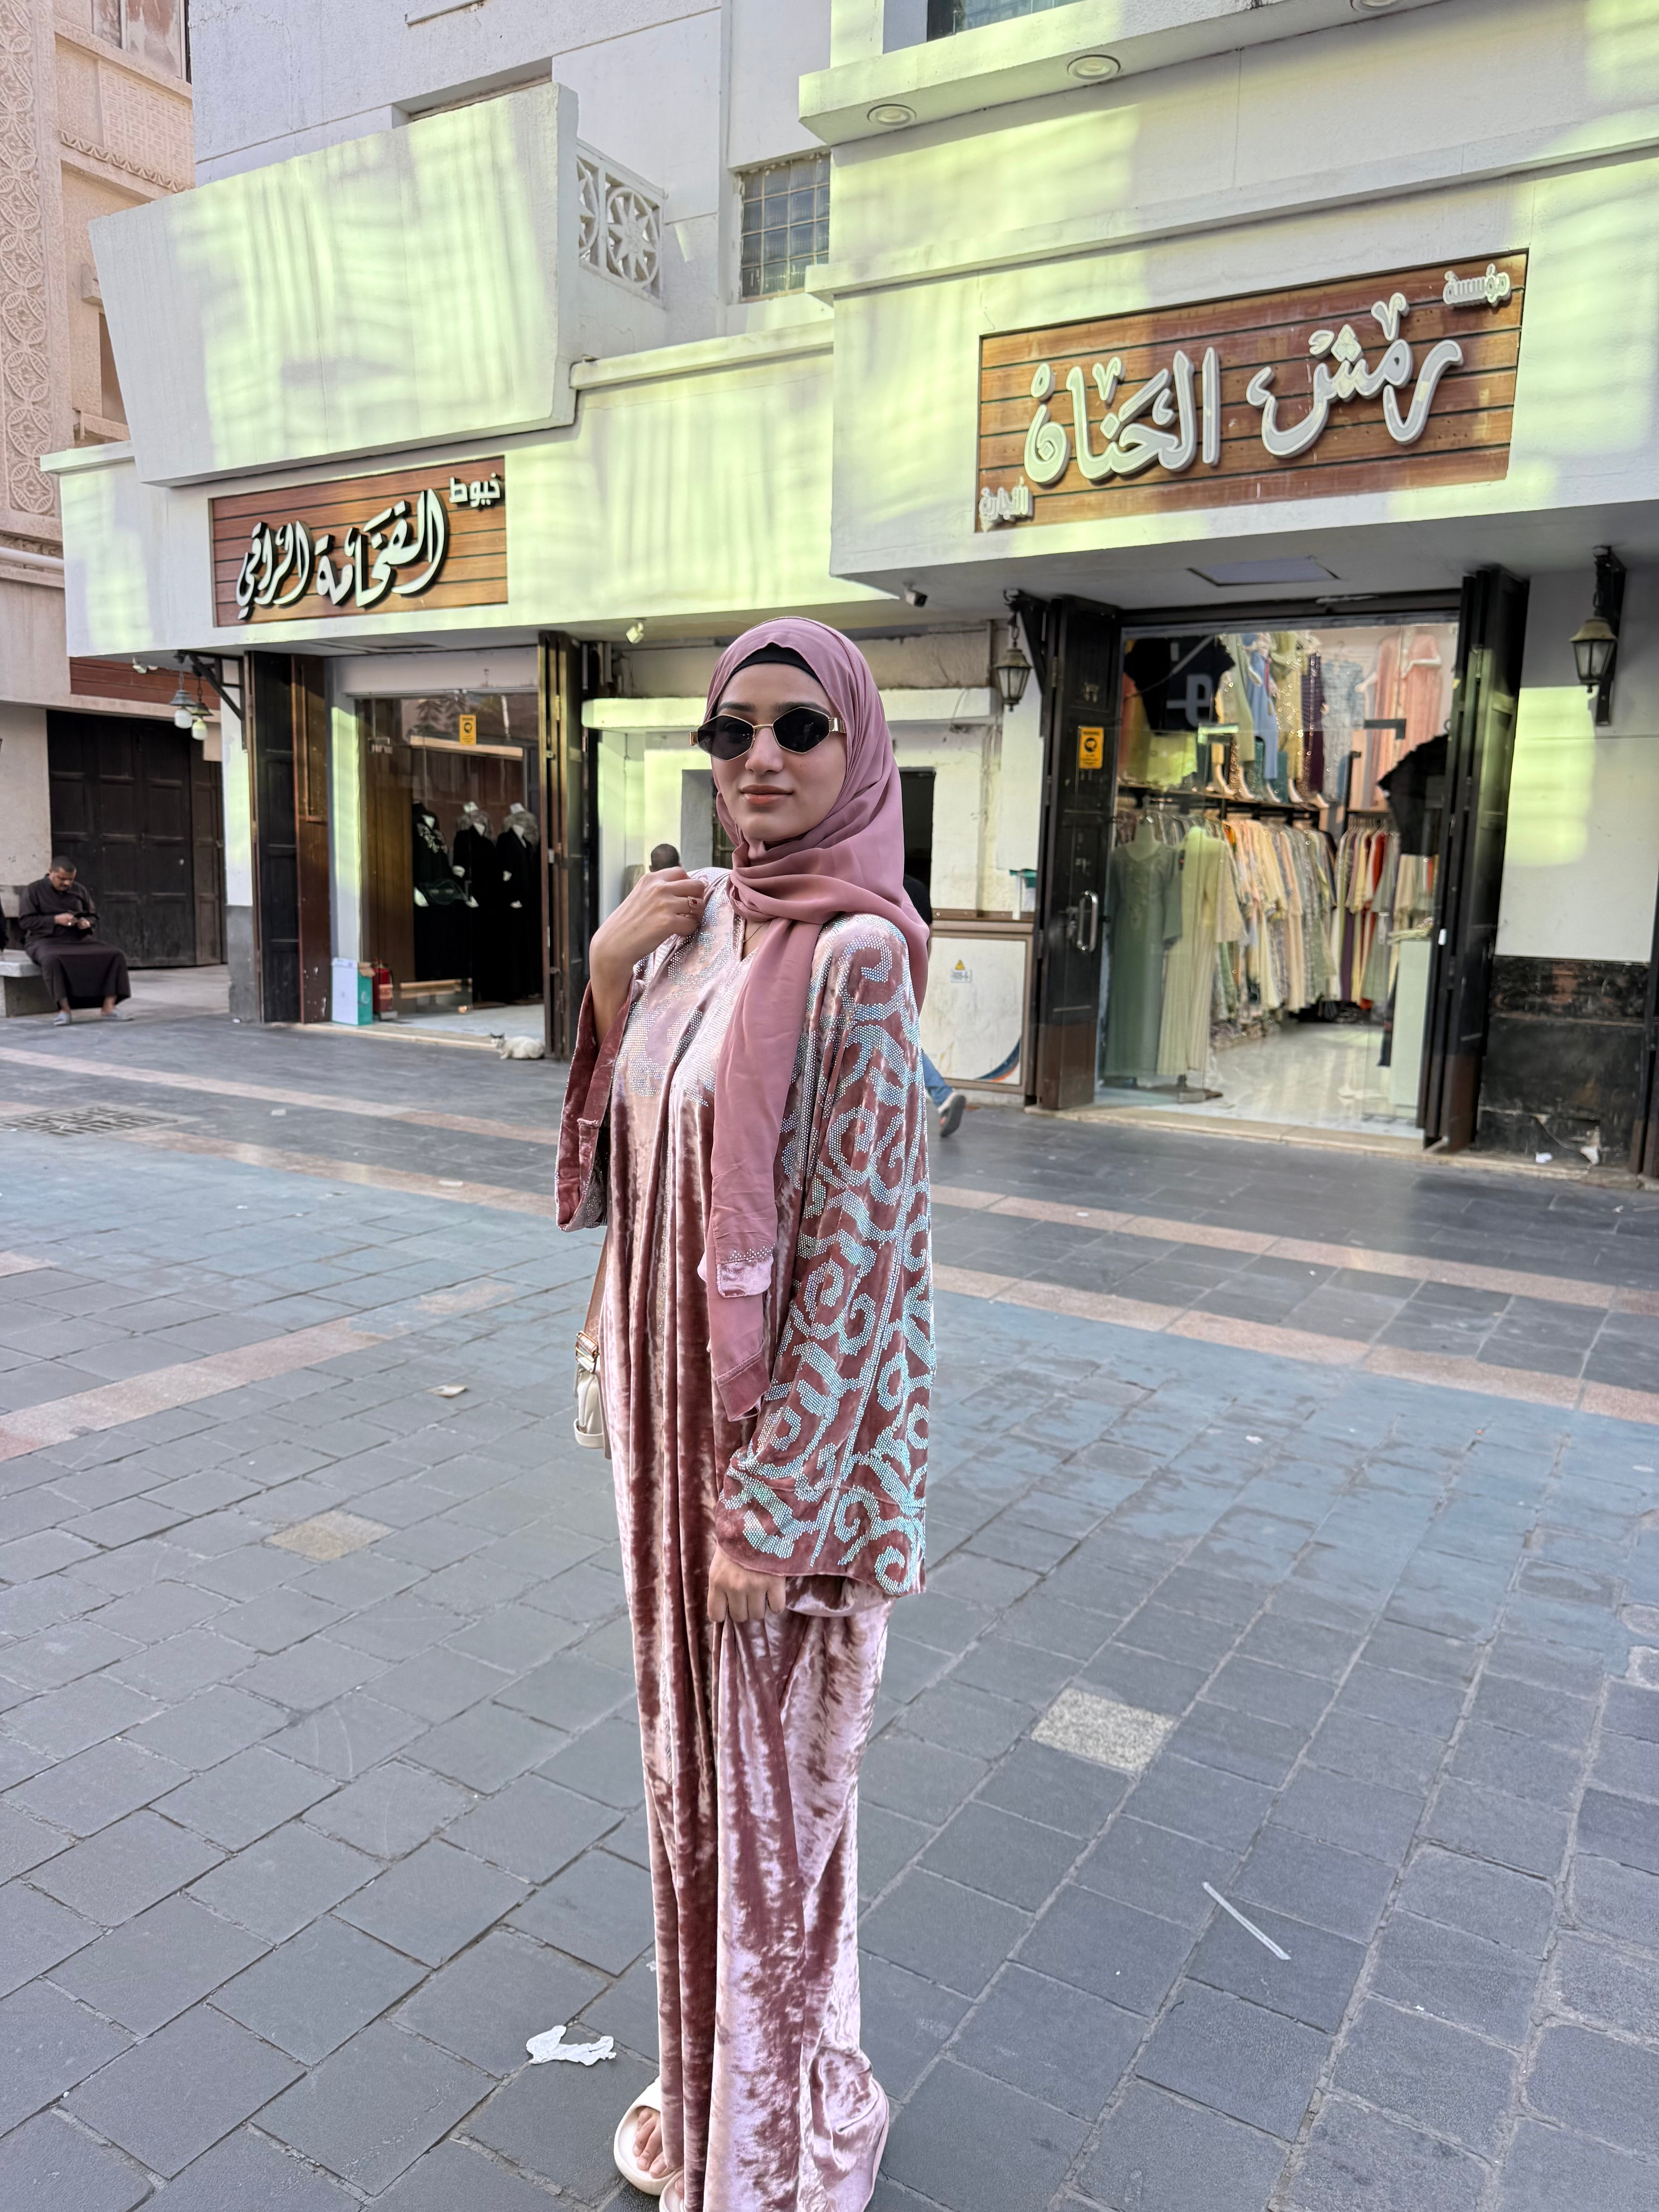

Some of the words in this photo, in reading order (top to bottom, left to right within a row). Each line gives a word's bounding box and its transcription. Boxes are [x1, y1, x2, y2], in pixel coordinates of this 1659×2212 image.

[1443, 263, 1510, 305] مؤسسة
[1024, 347, 1217, 483] الحنان
[1246, 292, 1463, 456] رمش
[449, 472, 500, 507] خيوط
[236, 520, 310, 620] الراقي
[314, 488, 445, 607] الفخامة
